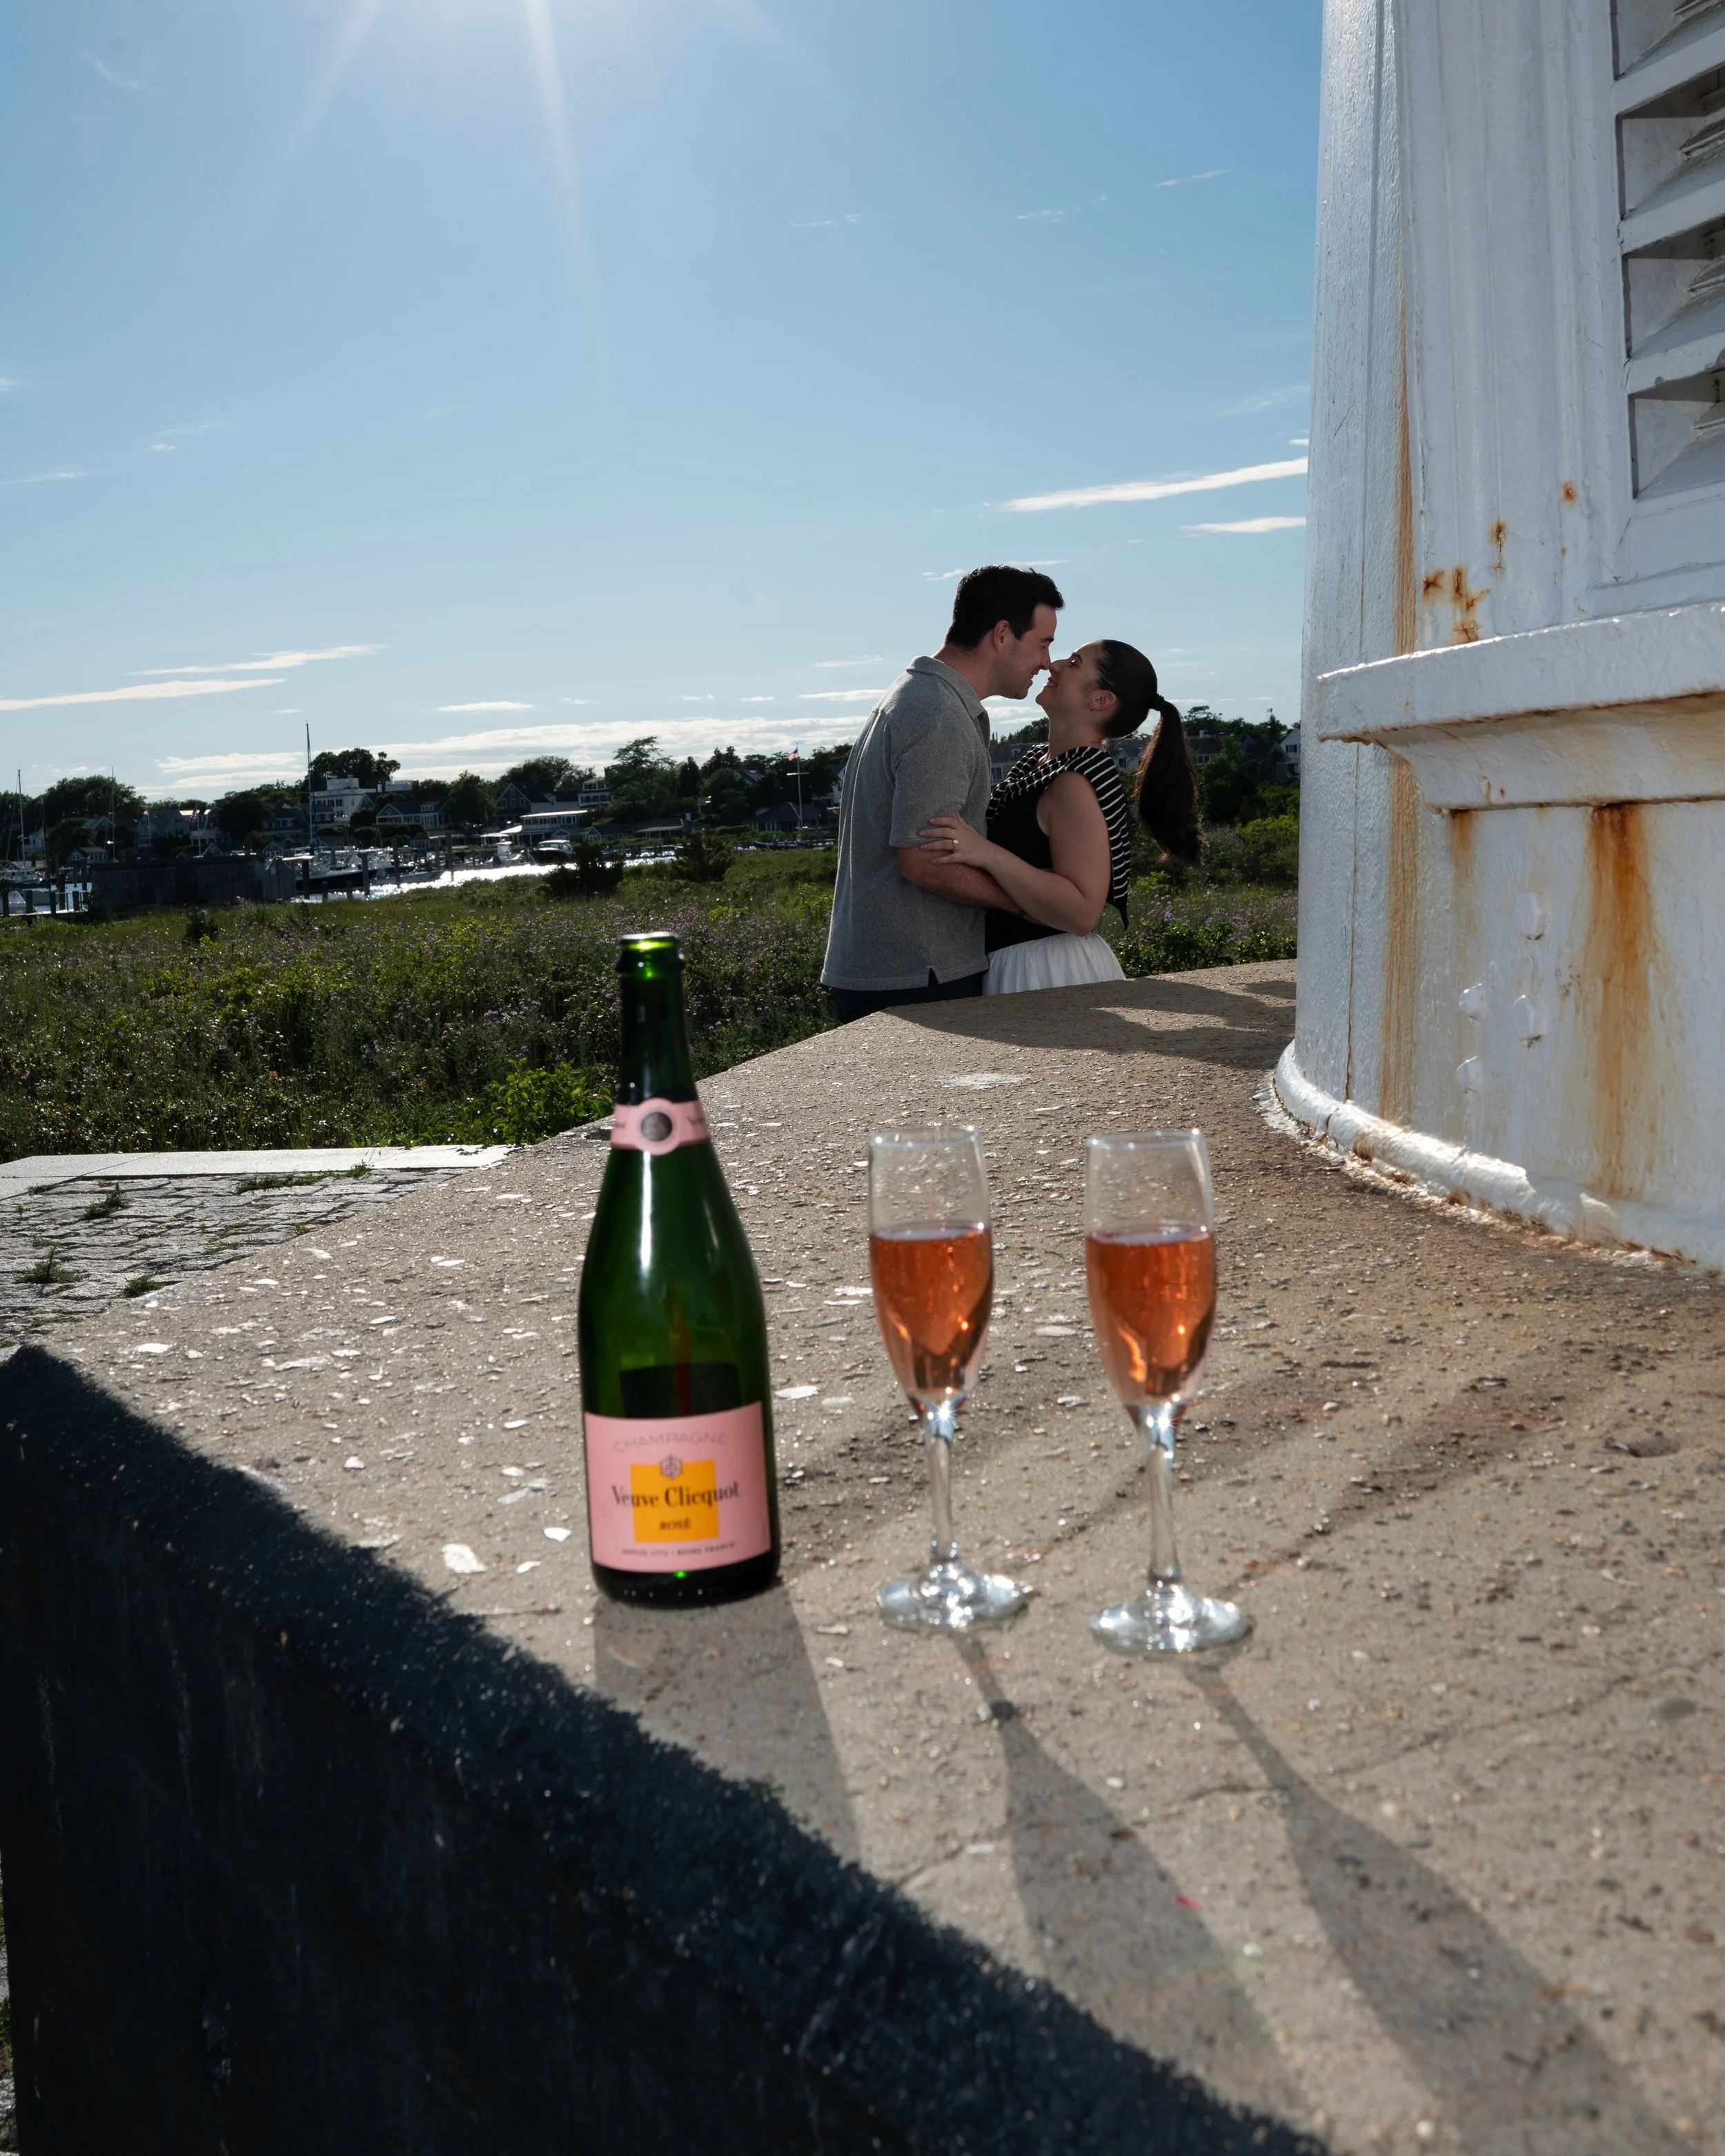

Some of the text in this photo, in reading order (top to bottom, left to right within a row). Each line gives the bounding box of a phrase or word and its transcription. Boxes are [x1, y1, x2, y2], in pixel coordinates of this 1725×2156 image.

[614, 1431, 727, 1453] CHAMPAGNE
[611, 1481, 739, 1507] Veuve Clicquot
[660, 1516, 691, 1530] ROSÉ
